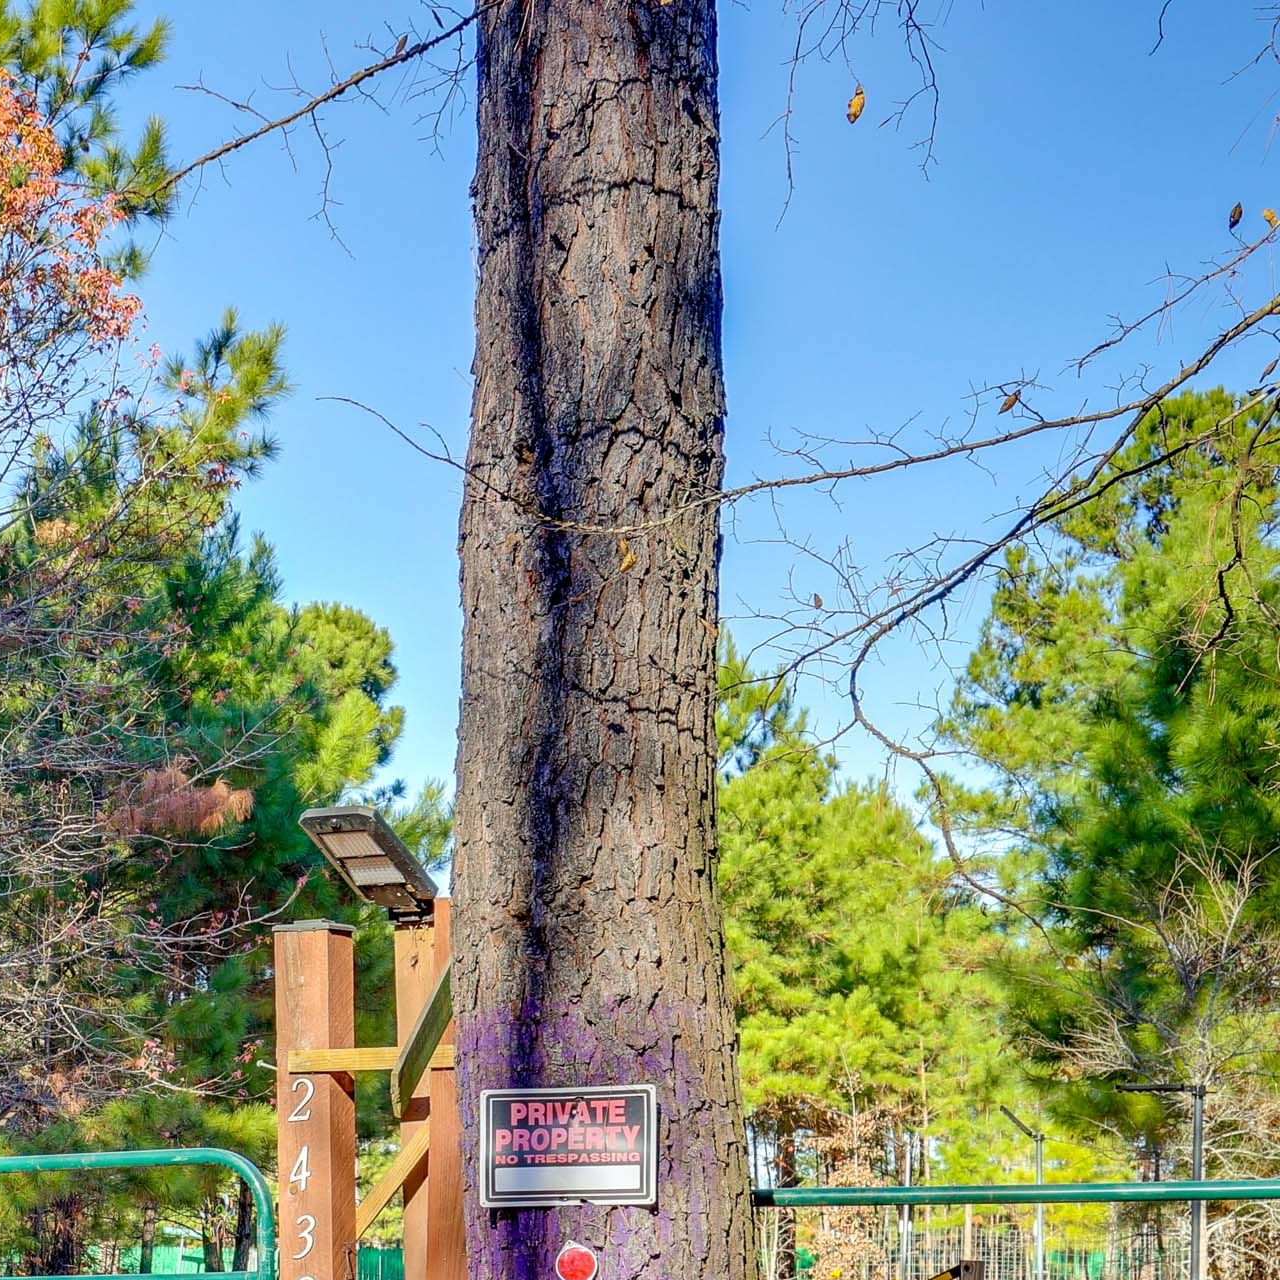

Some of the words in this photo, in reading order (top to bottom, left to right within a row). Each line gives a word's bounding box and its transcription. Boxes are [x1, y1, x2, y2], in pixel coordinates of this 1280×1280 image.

[510, 1099, 626, 1126] PRIVATE
[495, 1125, 641, 1151] PROPERTY
[495, 1154, 519, 1165] NO
[524, 1151, 641, 1164] TRESPASSING
